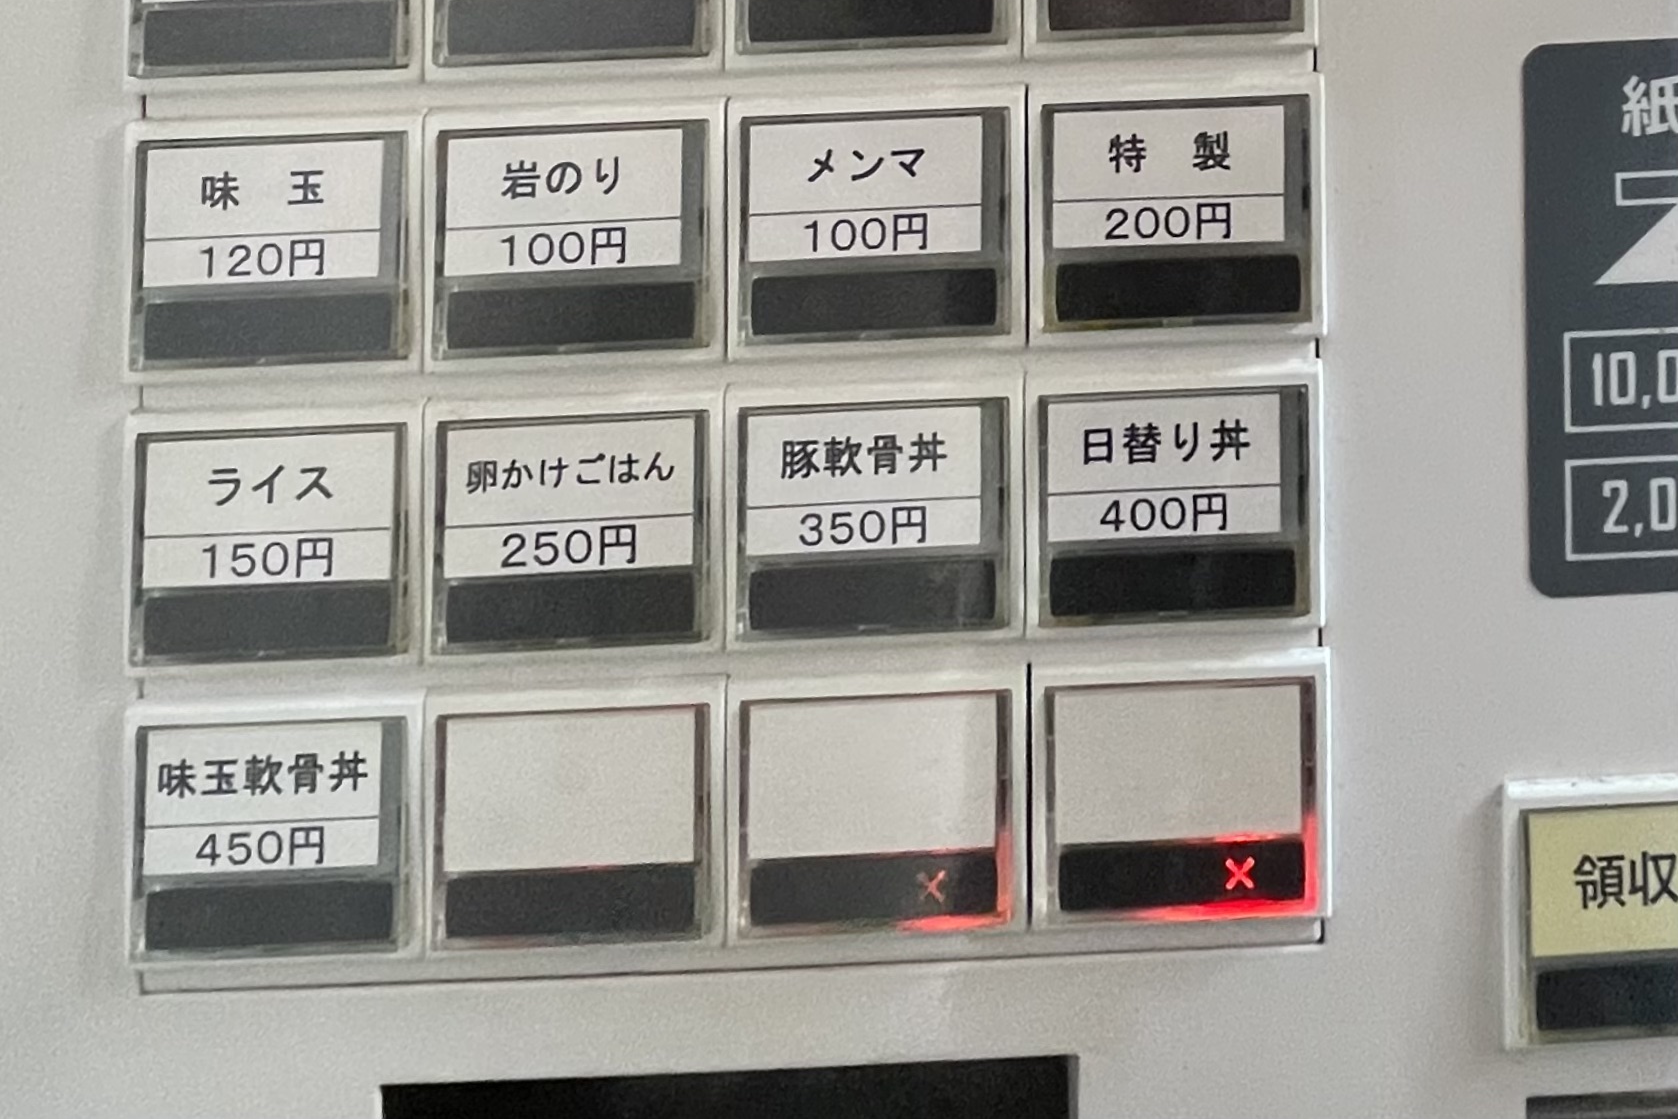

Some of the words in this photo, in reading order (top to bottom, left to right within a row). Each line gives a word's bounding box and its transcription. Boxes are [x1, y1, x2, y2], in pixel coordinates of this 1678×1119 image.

[1621, 74, 1678, 137] 紙
[501, 156, 619, 199] 岩のり
[808, 149, 925, 182] メンマ
[804, 213, 927, 252] 100円
[1105, 202, 1231, 240] 200円
[200, 239, 324, 278] 120円
[501, 227, 626, 266] 100円
[781, 433, 947, 479] 豚軟骨丼
[1084, 420, 1250, 465] 日替り丼
[208, 465, 333, 506] ライス
[466, 452, 674, 494] 卵かけごはん
[799, 506, 926, 546] 350円
[1100, 493, 1227, 532] 400円
[203, 538, 333, 578] 150円
[501, 524, 636, 568] 250円
[158, 751, 368, 798] 味玉軟骨丼
[196, 826, 324, 866] 450円
[1573, 850, 1678, 910] 領収
